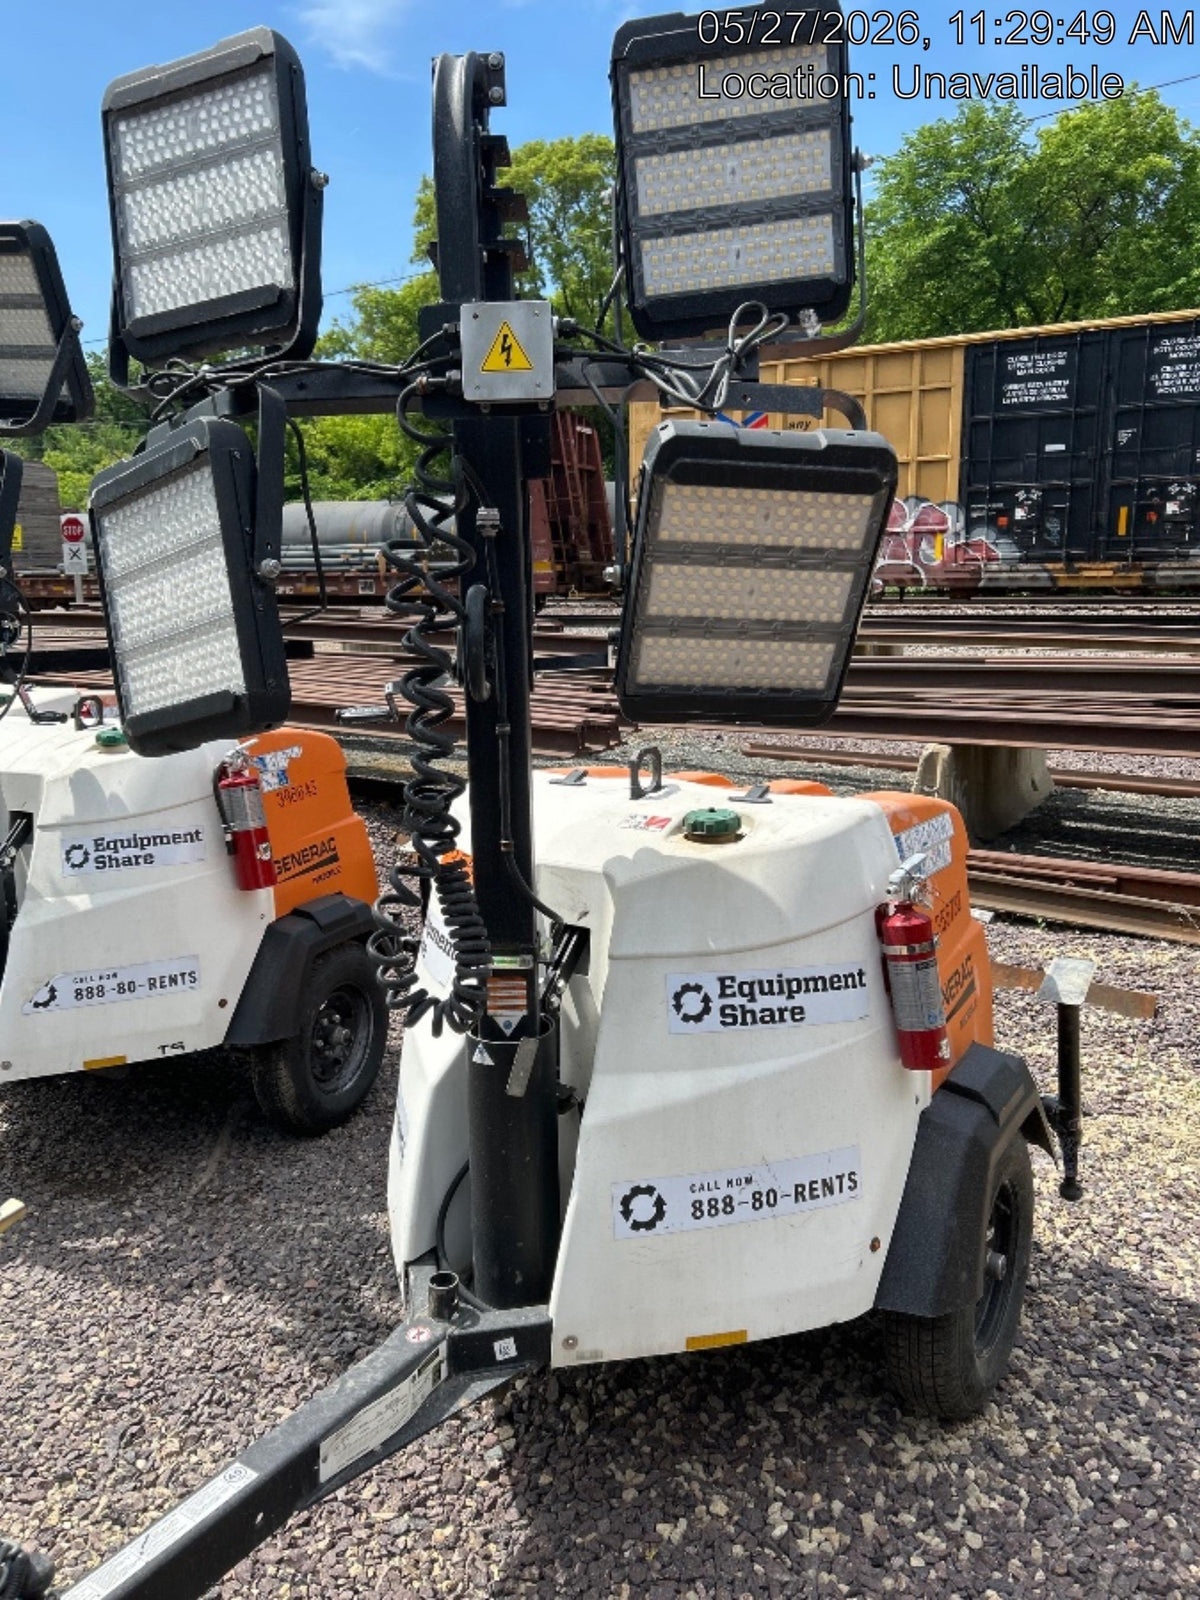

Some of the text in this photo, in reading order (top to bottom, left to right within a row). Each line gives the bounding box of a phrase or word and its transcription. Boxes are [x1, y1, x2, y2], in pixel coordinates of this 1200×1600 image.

[63, 525, 83, 536] STOP
[92, 828, 204, 854] Equipment
[94, 851, 155, 871] Share
[273, 836, 337, 876] GENERAC
[73, 970, 198, 1002] 888-80-RENTS
[717, 968, 867, 1003] Equipment
[719, 1004, 806, 1028] Share
[689, 1175, 753, 1194] CALL NOW
[690, 1171, 858, 1221] 888-80-RENTS
